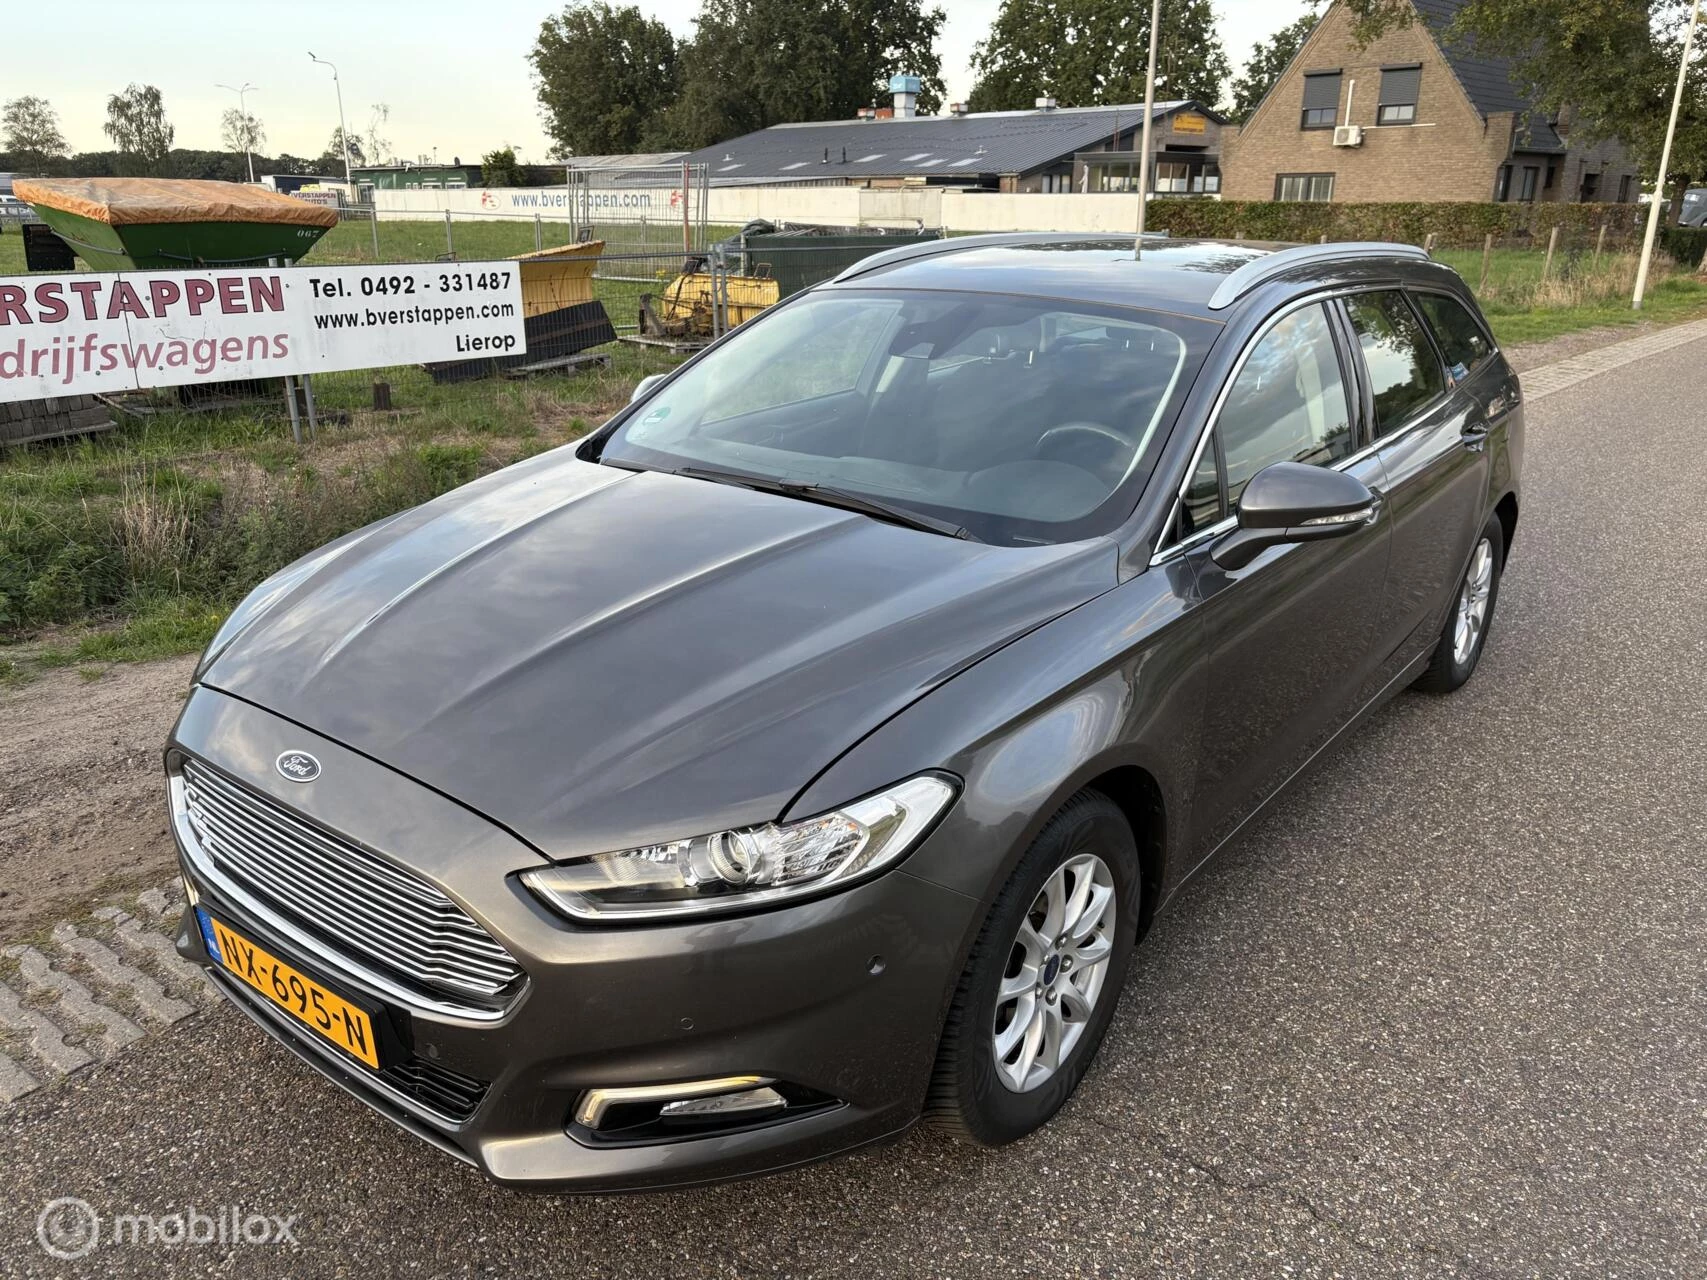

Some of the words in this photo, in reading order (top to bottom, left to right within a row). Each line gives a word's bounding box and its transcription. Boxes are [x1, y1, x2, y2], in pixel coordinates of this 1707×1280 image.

[511, 191, 651, 211] www.bverappen.com
[296, 230, 320, 238] 067
[309, 278, 352, 298] Tel.
[360, 275, 416, 296] 0492
[439, 272, 511, 293] 331487
[314, 303, 514, 329] www.bverstappen.com
[456, 334, 516, 352] Lierop
[0, 333, 289, 385] drijfswagens
[283, 755, 313, 776] Ford
[219, 928, 368, 1056] NX-695-N
